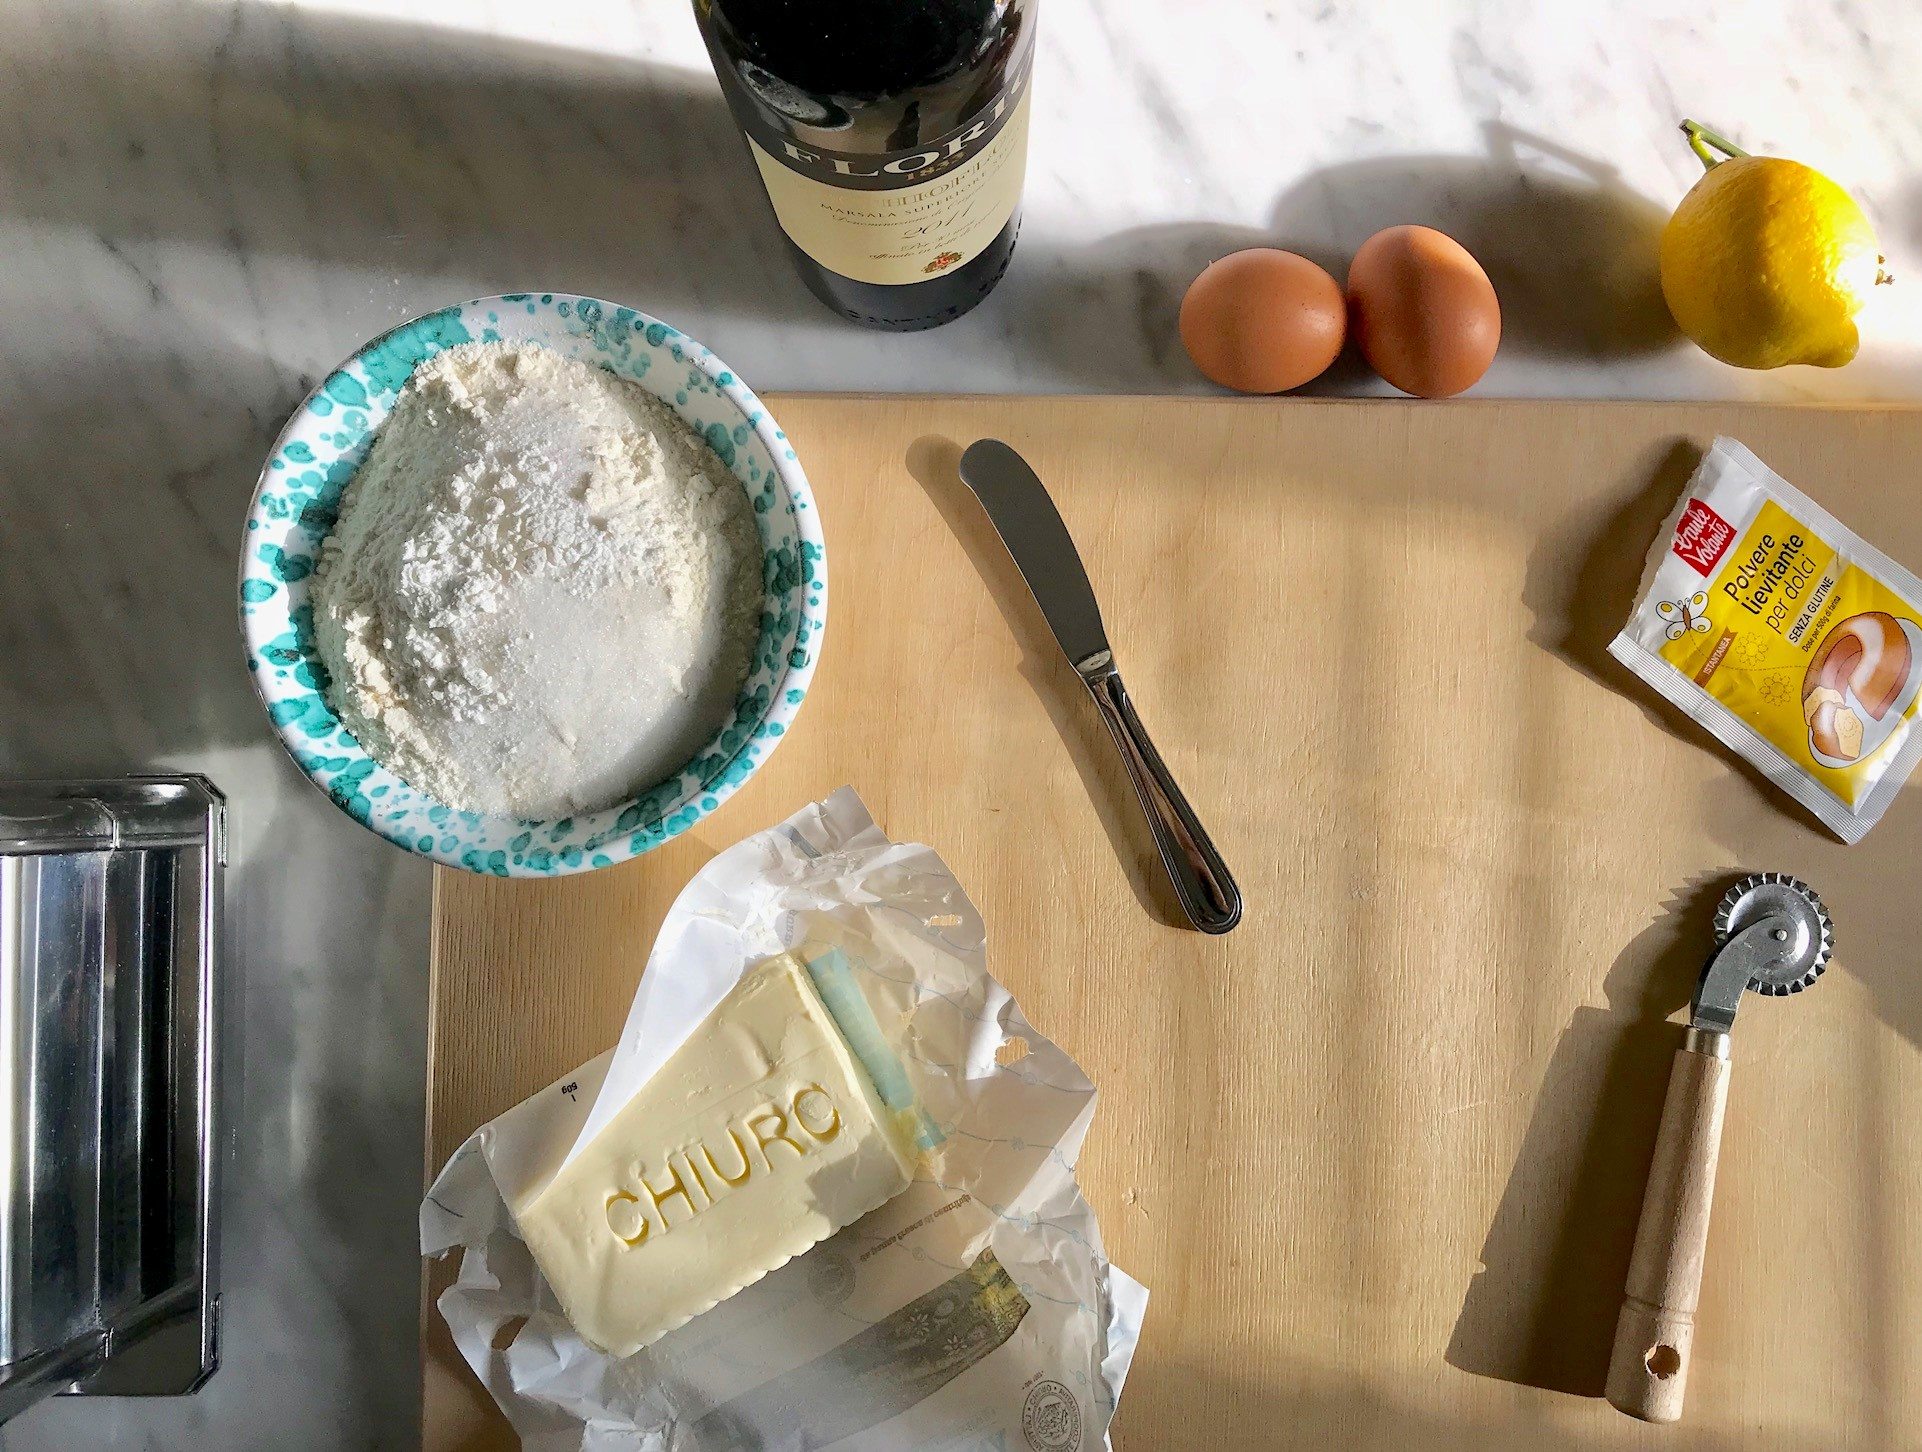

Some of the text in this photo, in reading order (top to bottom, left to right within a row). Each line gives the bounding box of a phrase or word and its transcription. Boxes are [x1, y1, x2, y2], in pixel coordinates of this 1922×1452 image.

[820, 203, 897, 218] MARSALA
[901, 199, 977, 239] 2011
[1682, 517, 1730, 567] Volante
[1723, 534, 1775, 602] Polvere
[1740, 534, 1804, 615] lievitante
[1765, 553, 1817, 635] per dolci
[1788, 576, 1834, 643] SENZA GLUTINE
[1703, 637, 1731, 675] ISTANTANEA
[1801, 638, 1815, 653] Dose
[605, 1081, 841, 1251] CHIURO
